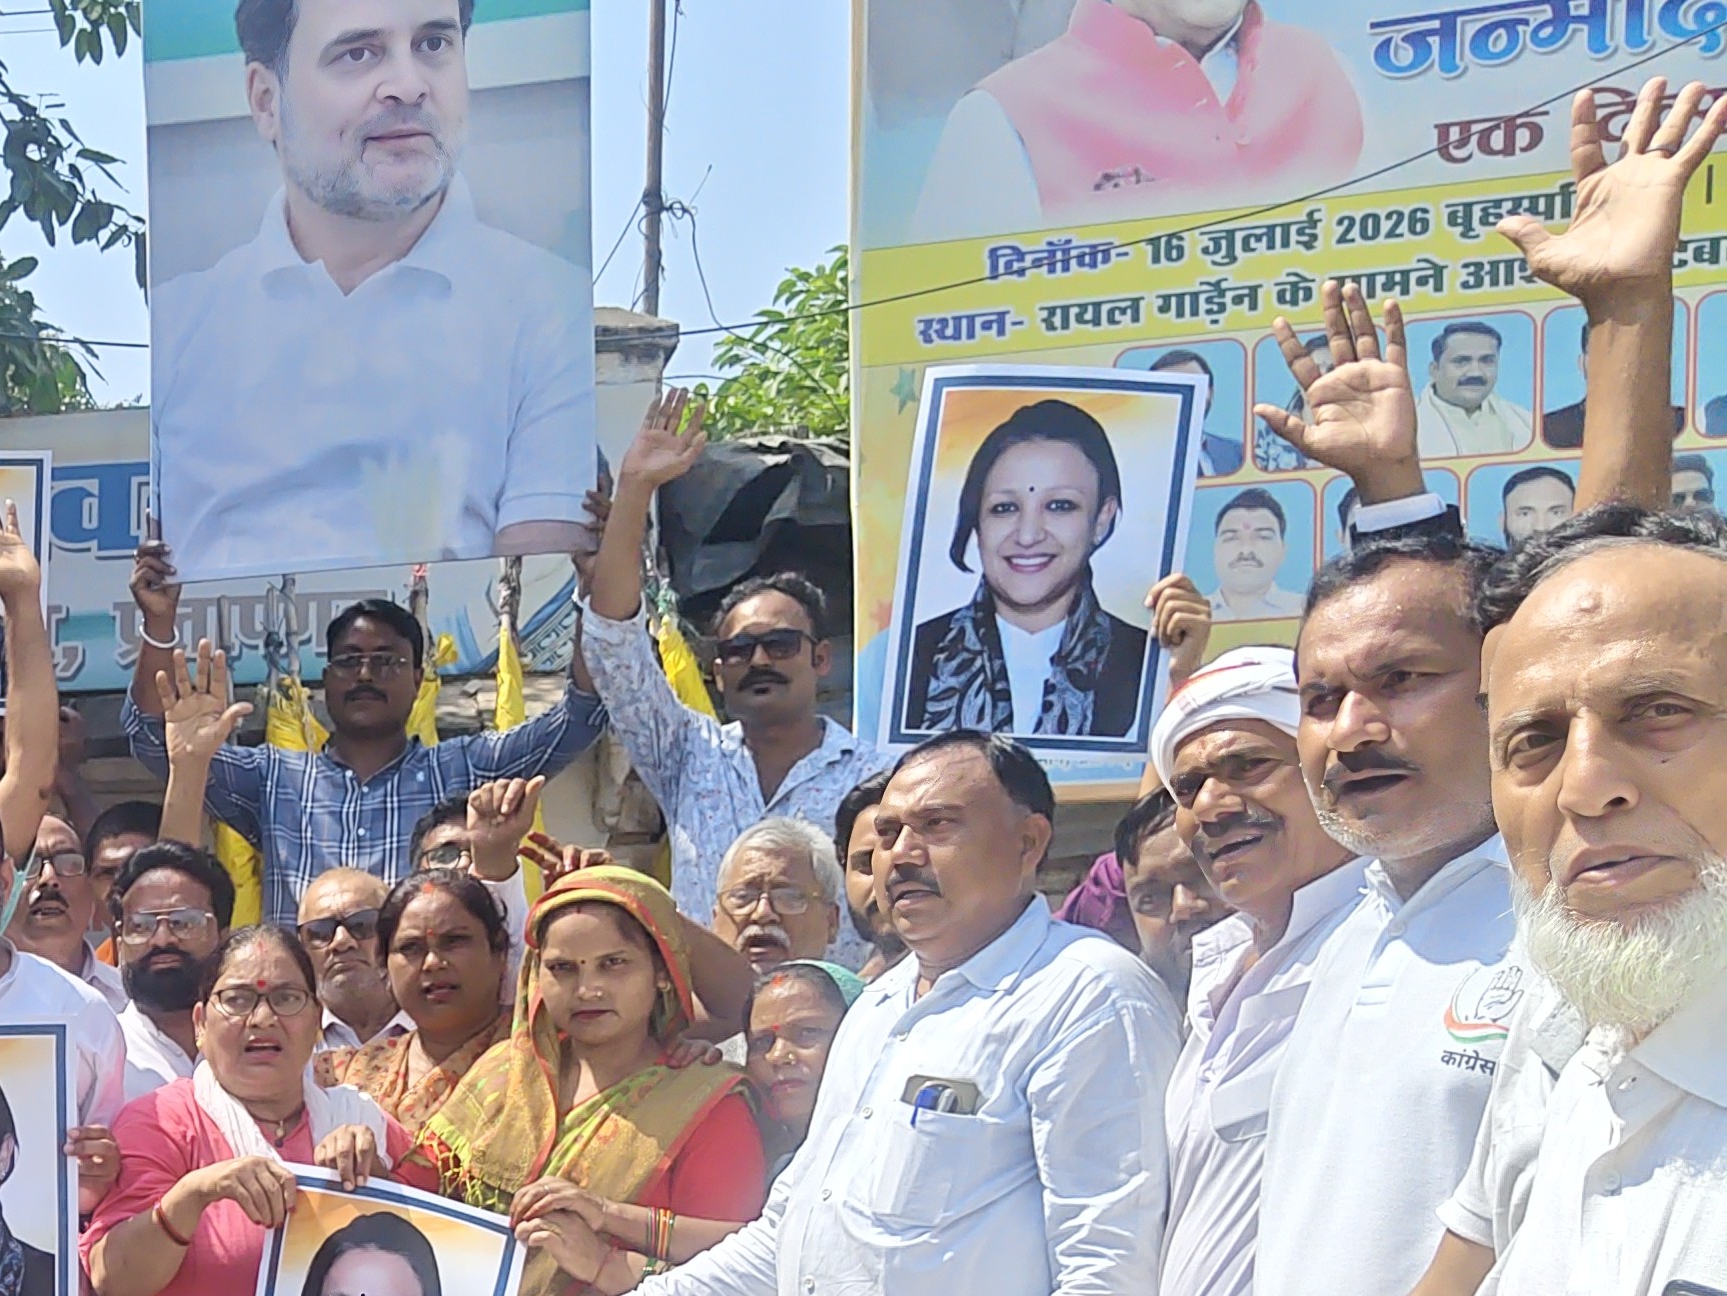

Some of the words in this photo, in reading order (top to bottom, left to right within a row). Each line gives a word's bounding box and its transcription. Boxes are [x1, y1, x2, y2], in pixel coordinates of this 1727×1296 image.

[1433, 110, 1550, 164] एक
[1146, 234, 1185, 265] 16
[1200, 208, 1322, 266] जुलाई
[1335, 207, 1430, 245] 2026
[918, 310, 1024, 343] स्थान-
[1039, 296, 1145, 331] रायल
[1274, 272, 1316, 307] के
[1440, 1049, 1496, 1076] कांग्रेस
